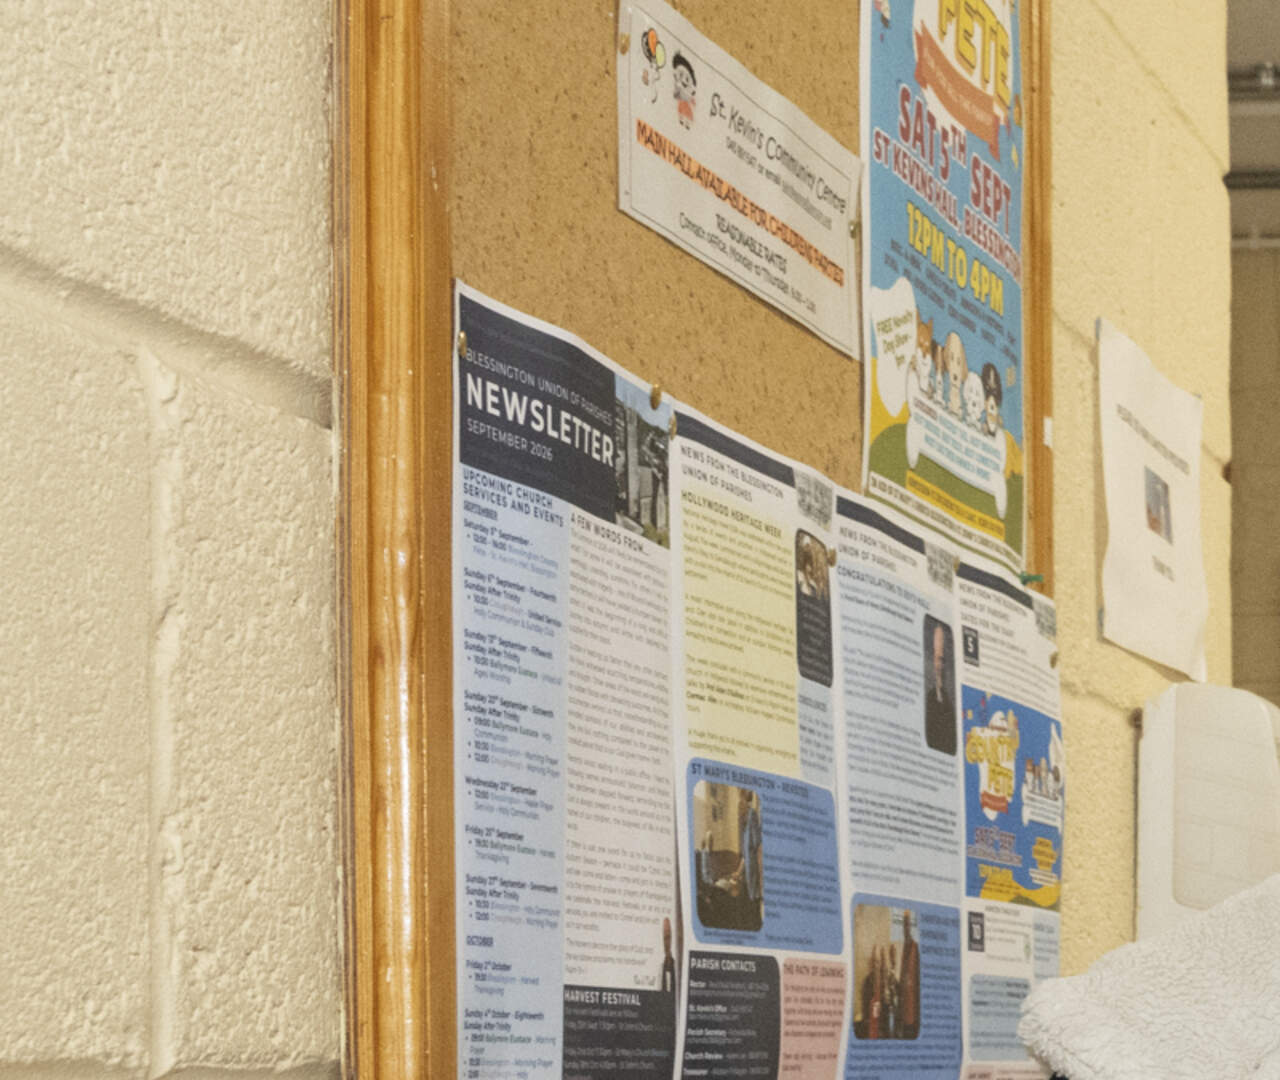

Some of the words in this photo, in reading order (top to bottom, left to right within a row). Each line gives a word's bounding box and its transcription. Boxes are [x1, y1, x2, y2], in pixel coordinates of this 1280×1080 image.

[710, 93, 727, 120] St.
[728, 106, 764, 150] Kevin's
[766, 136, 816, 190] Community
[816, 176, 847, 214] Centre
[874, 130, 890, 168] ST
[900, 86, 936, 167] SAT
[940, 124, 967, 182] 5TH
[971, 155, 1011, 236] SEPT
[637, 119, 668, 160] MAIN
[668, 137, 694, 180] HALL
[694, 159, 749, 217] AVAILABLE
[750, 198, 769, 233] FOR
[716, 213, 765, 259] REASONABLE
[907, 202, 945, 274] 12PM
[947, 239, 968, 289] TO
[971, 259, 1004, 316] 4PM
[467, 349, 535, 387] BLESSINGTON
[538, 377, 569, 400] UNION
[571, 391, 580, 404] OF
[581, 396, 613, 426] PARISHES
[467, 373, 614, 467] NEWSLETTER
[467, 418, 528, 450] SEPTEMBER
[463, 467, 512, 495] UPCOMING
[516, 487, 552, 510] CHURCH
[681, 445, 704, 463] NEWS
[706, 454, 725, 471] FROM
[727, 464, 739, 478] THE
[741, 470, 784, 499] BLESSINGTON
[682, 464, 708, 482] UNION
[710, 474, 719, 486] OF
[721, 480, 752, 502] PARISHES
[463, 482, 508, 509] SERVICES
[511, 497, 531, 515] AND
[534, 506, 564, 528] EVENTS
[681, 489, 729, 517] HOLLYWOOD
[731, 508, 763, 532] HERITAGE
[764, 523, 782, 539] WEEK
[594, 522, 622, 546] WORDS
[860, 532, 877, 546] FROM
[692, 763, 702, 775] ST
[690, 957, 720, 971] PARISH
[721, 959, 756, 973] CONTACTS
[564, 989, 600, 1004] HARVEST
[602, 991, 641, 1006] FESTIVAL
